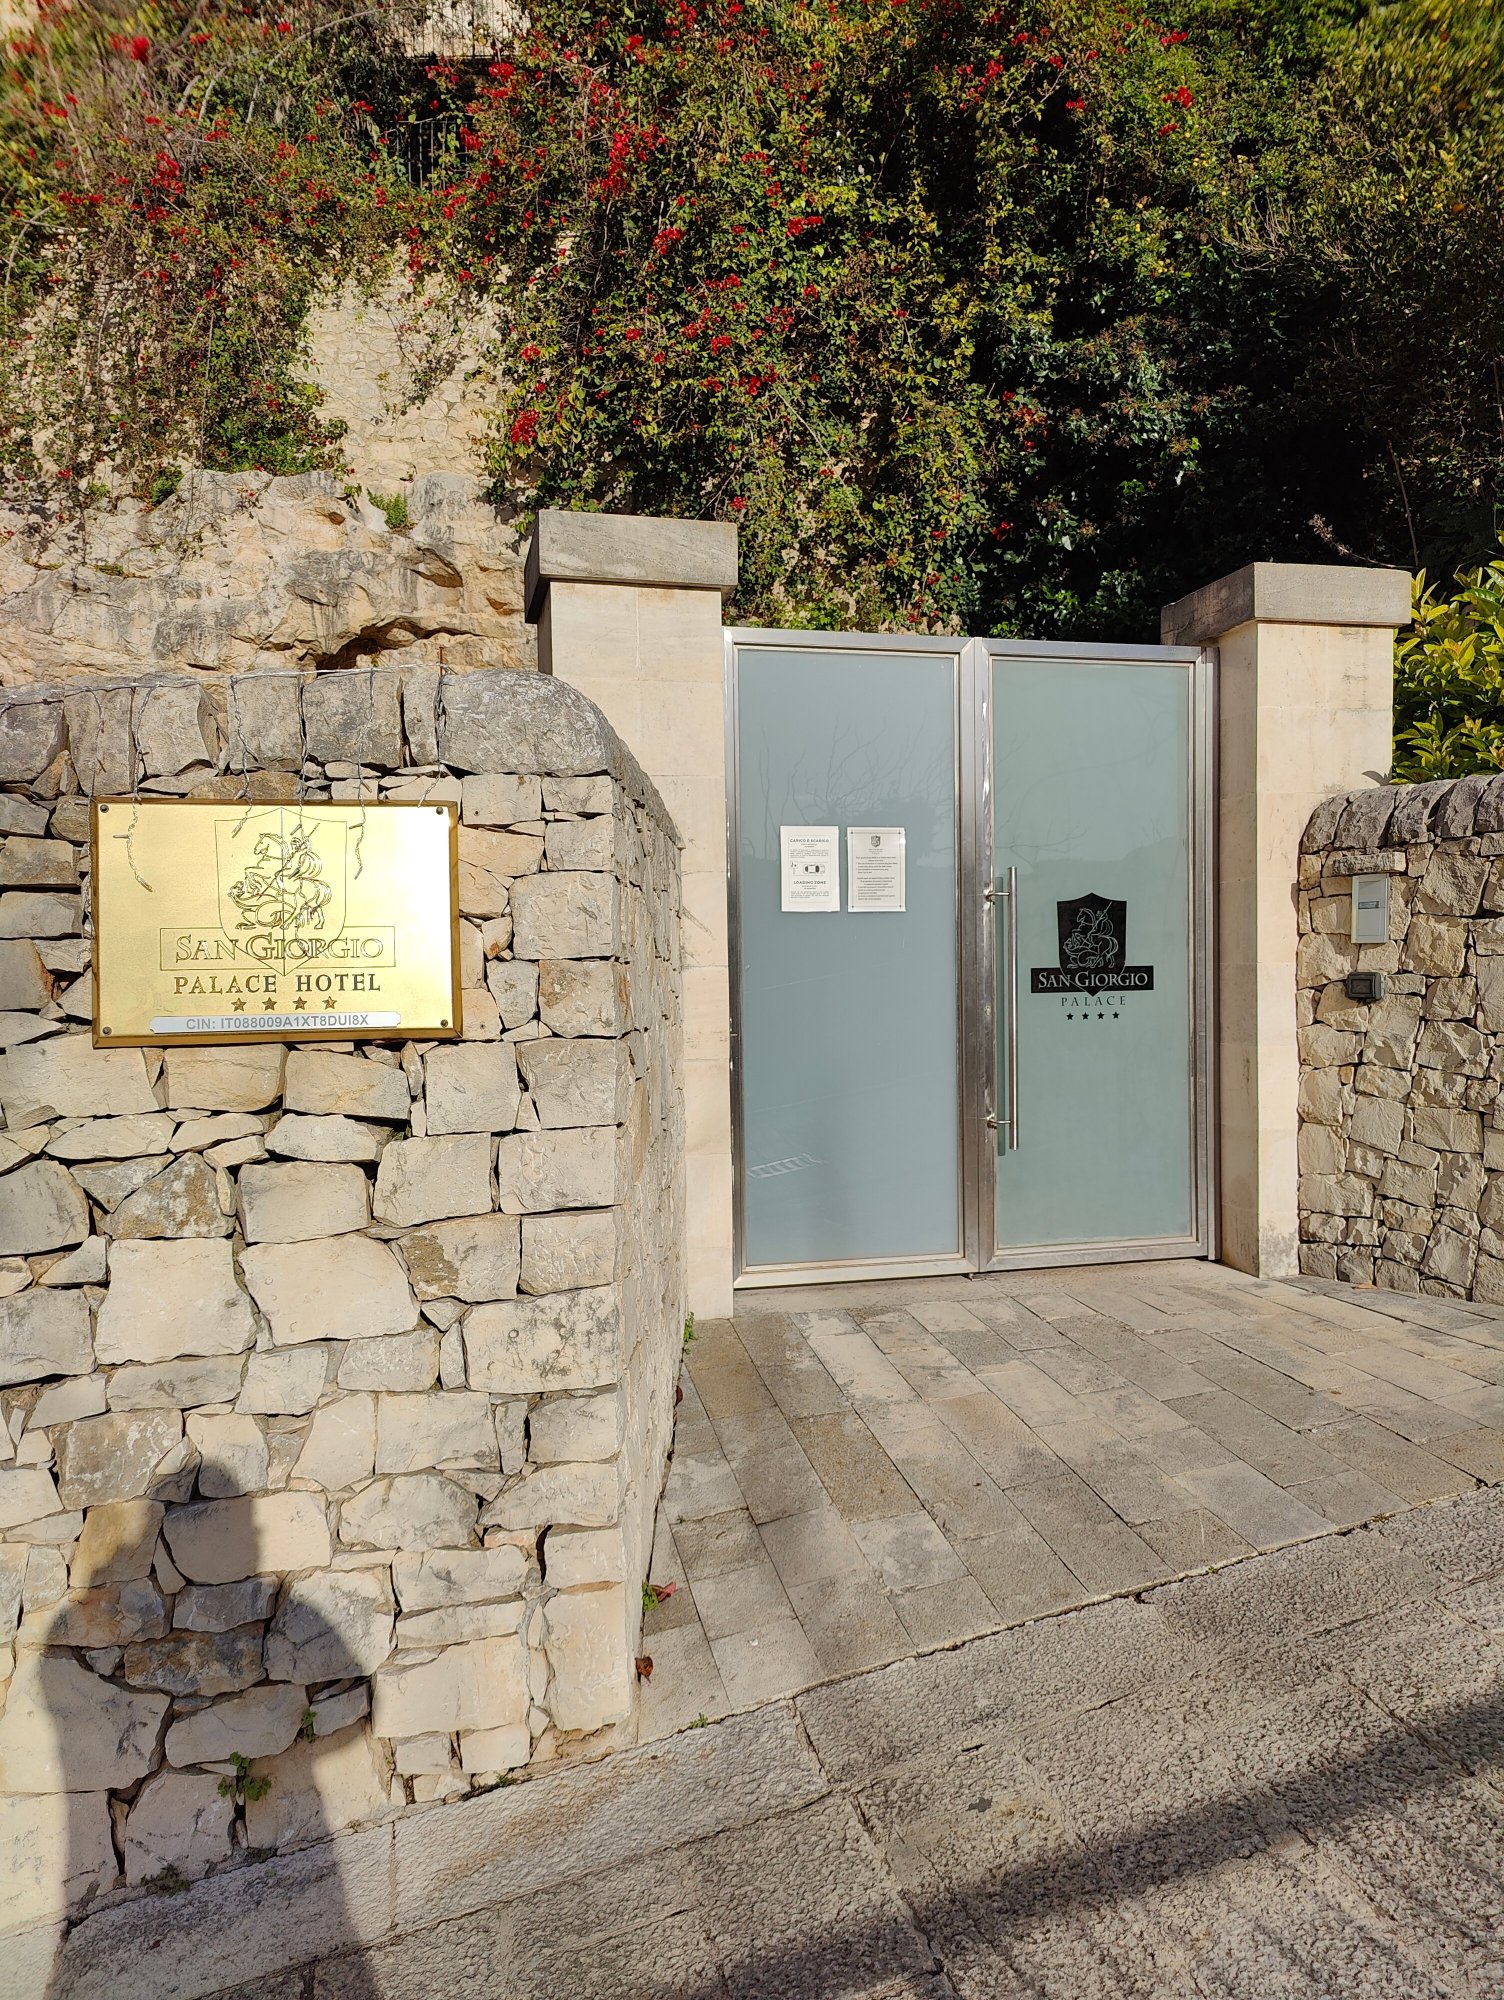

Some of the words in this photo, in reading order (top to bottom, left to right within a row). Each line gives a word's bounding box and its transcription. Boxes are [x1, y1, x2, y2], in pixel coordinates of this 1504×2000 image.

[173, 974, 277, 995] PALACE
[295, 973, 381, 993] HOTEL
[1061, 995, 1126, 1007] PALACE
[186, 1018, 216, 1030] CIN:
[220, 1014, 369, 1029] IT088009A1XT8DUI8X
